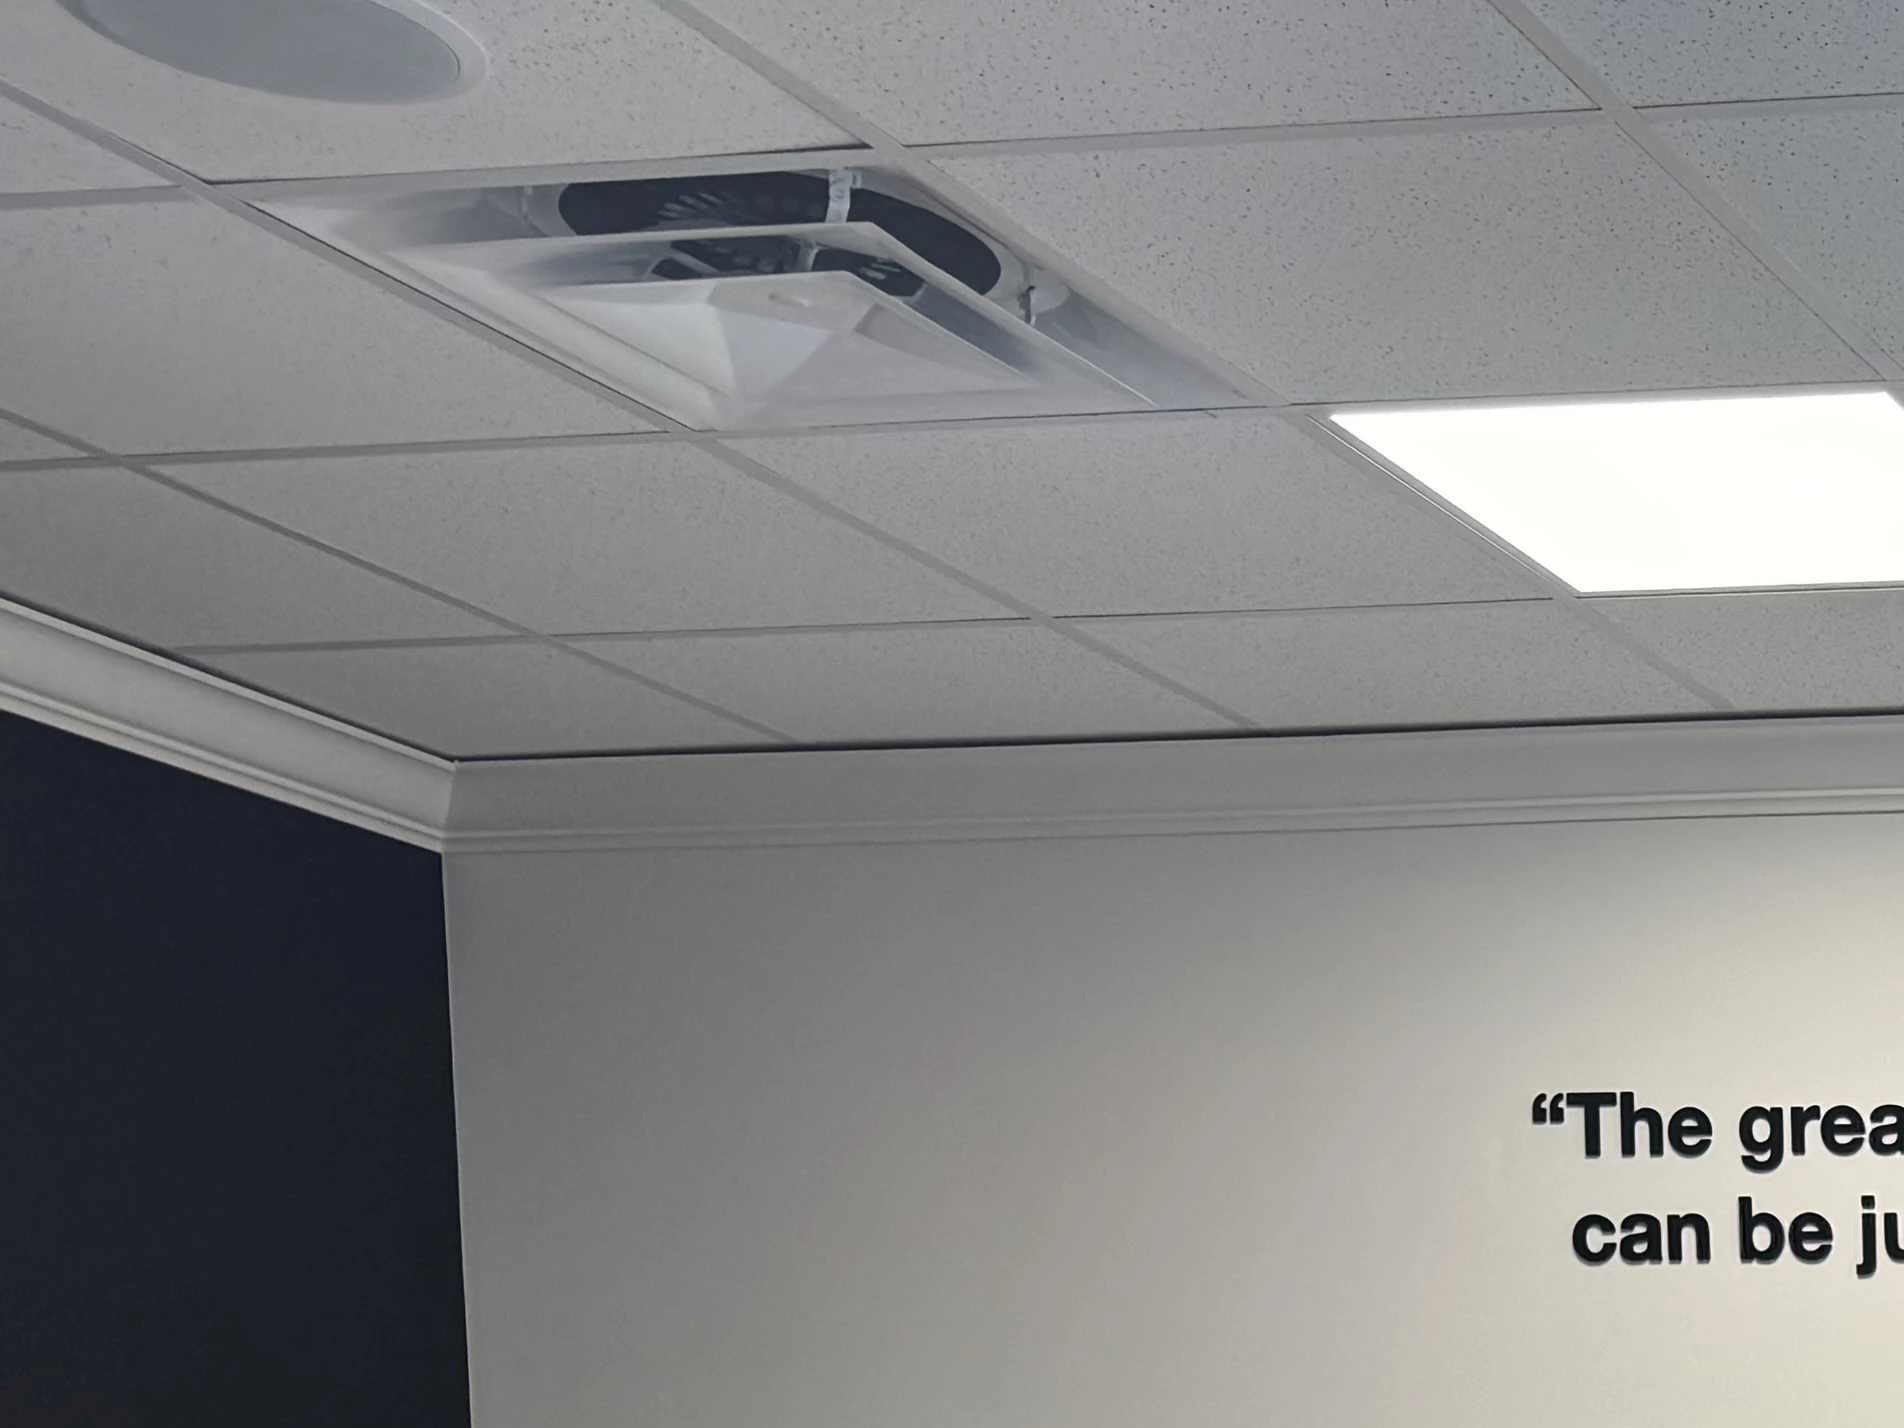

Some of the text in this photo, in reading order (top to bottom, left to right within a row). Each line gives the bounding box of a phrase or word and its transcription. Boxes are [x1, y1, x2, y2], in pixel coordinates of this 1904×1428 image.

[1533, 1092, 1713, 1158] “The
[1572, 1212, 1711, 1264] can
[1738, 1197, 1833, 1264] be
